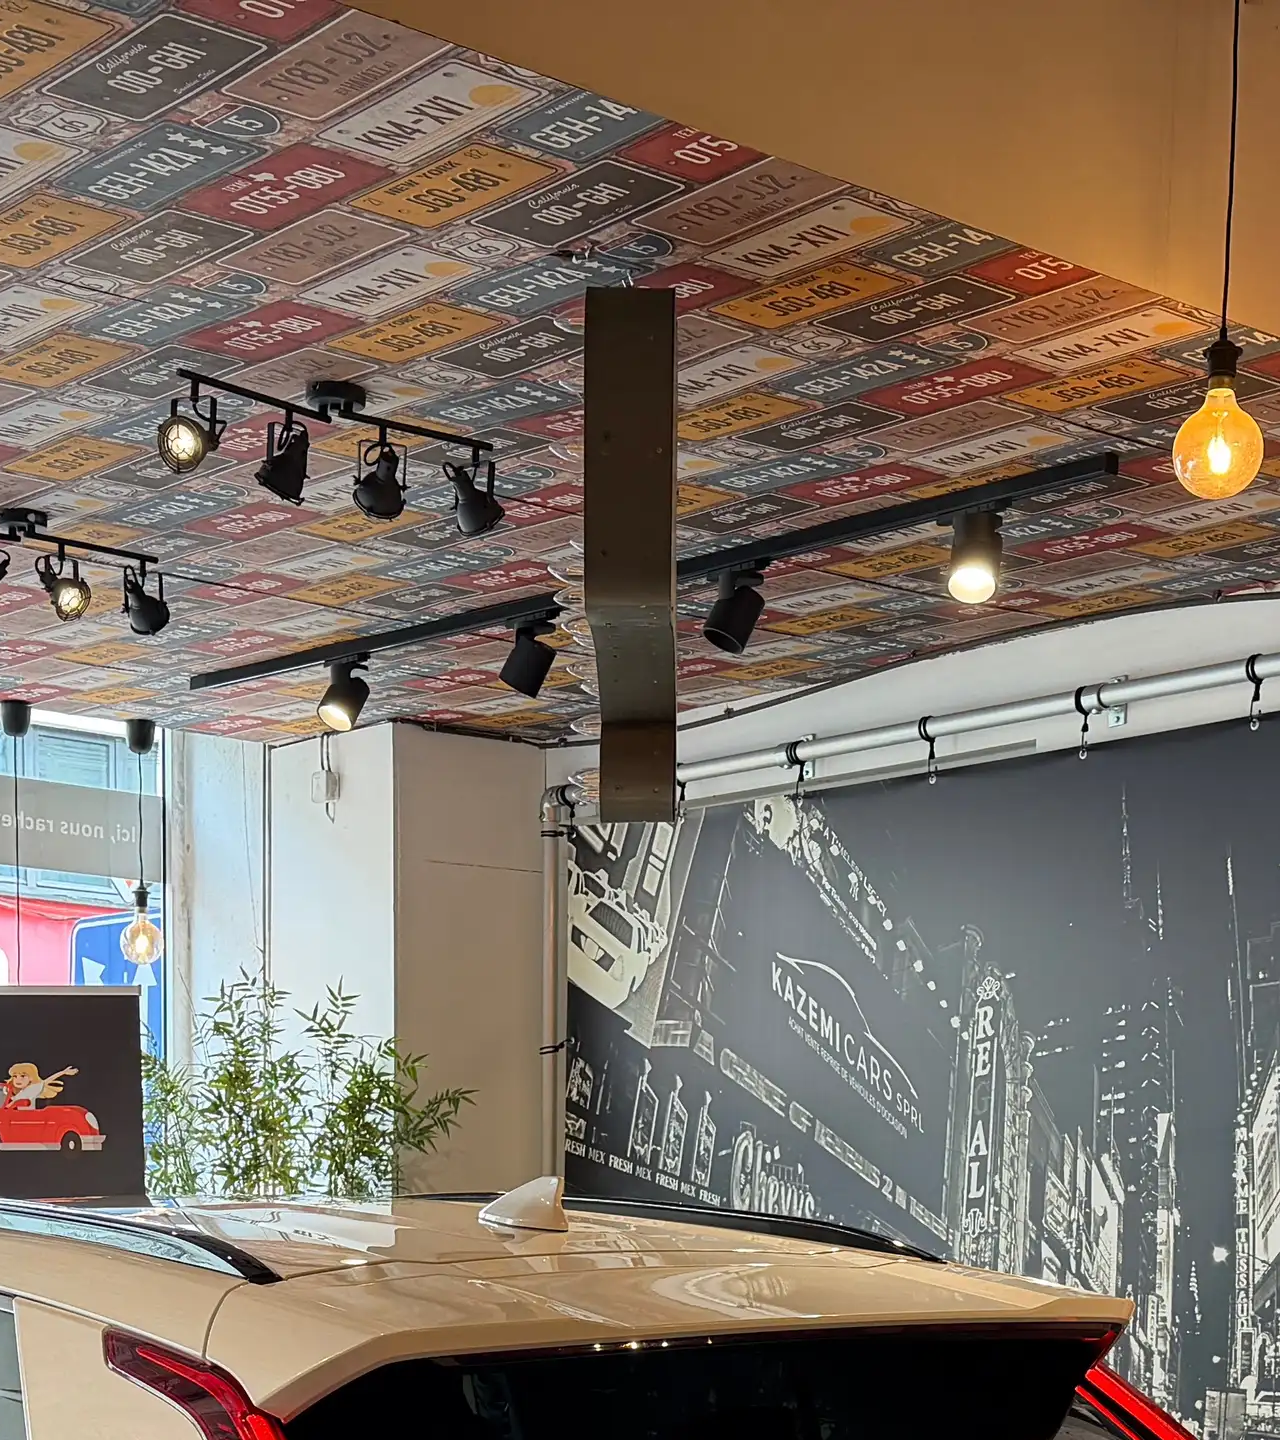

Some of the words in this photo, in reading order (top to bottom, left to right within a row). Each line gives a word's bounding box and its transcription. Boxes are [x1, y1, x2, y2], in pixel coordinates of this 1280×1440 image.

[96, 43, 148, 75] California
[53, 116, 86, 132] 66
[223, 113, 264, 132] 15
[356, 94, 475, 152] KN4-XV1
[530, 98, 642, 151] GEH-14
[87, 147, 204, 200] GEH-142A
[221, 181, 252, 193] TEXAS
[384, 179, 421, 197] NEW
[418, 160, 462, 184] YORK
[528, 184, 580, 210] California
[734, 225, 850, 276] KN4-XV1
[892, 228, 997, 268] GEH-14
[329, 268, 431, 315] KN4-XV1
[870, 295, 922, 312] California
[1040, 328, 1150, 364] KN4-XV1
[771, 961, 840, 1052] KAZEMI
[844, 1034, 893, 1101] CARS
[896, 1093, 924, 1133] SPRL
[968, 1005, 994, 1199] REGAL
[564, 1139, 586, 1158] RESH
[588, 1148, 606, 1164] MEX
[608, 1155, 633, 1174] FRESH
[635, 1166, 652, 1181] MEX
[655, 1173, 678, 1191] FRESH
[680, 1181, 696, 1198] MEX
[699, 1189, 720, 1206] FRESH
